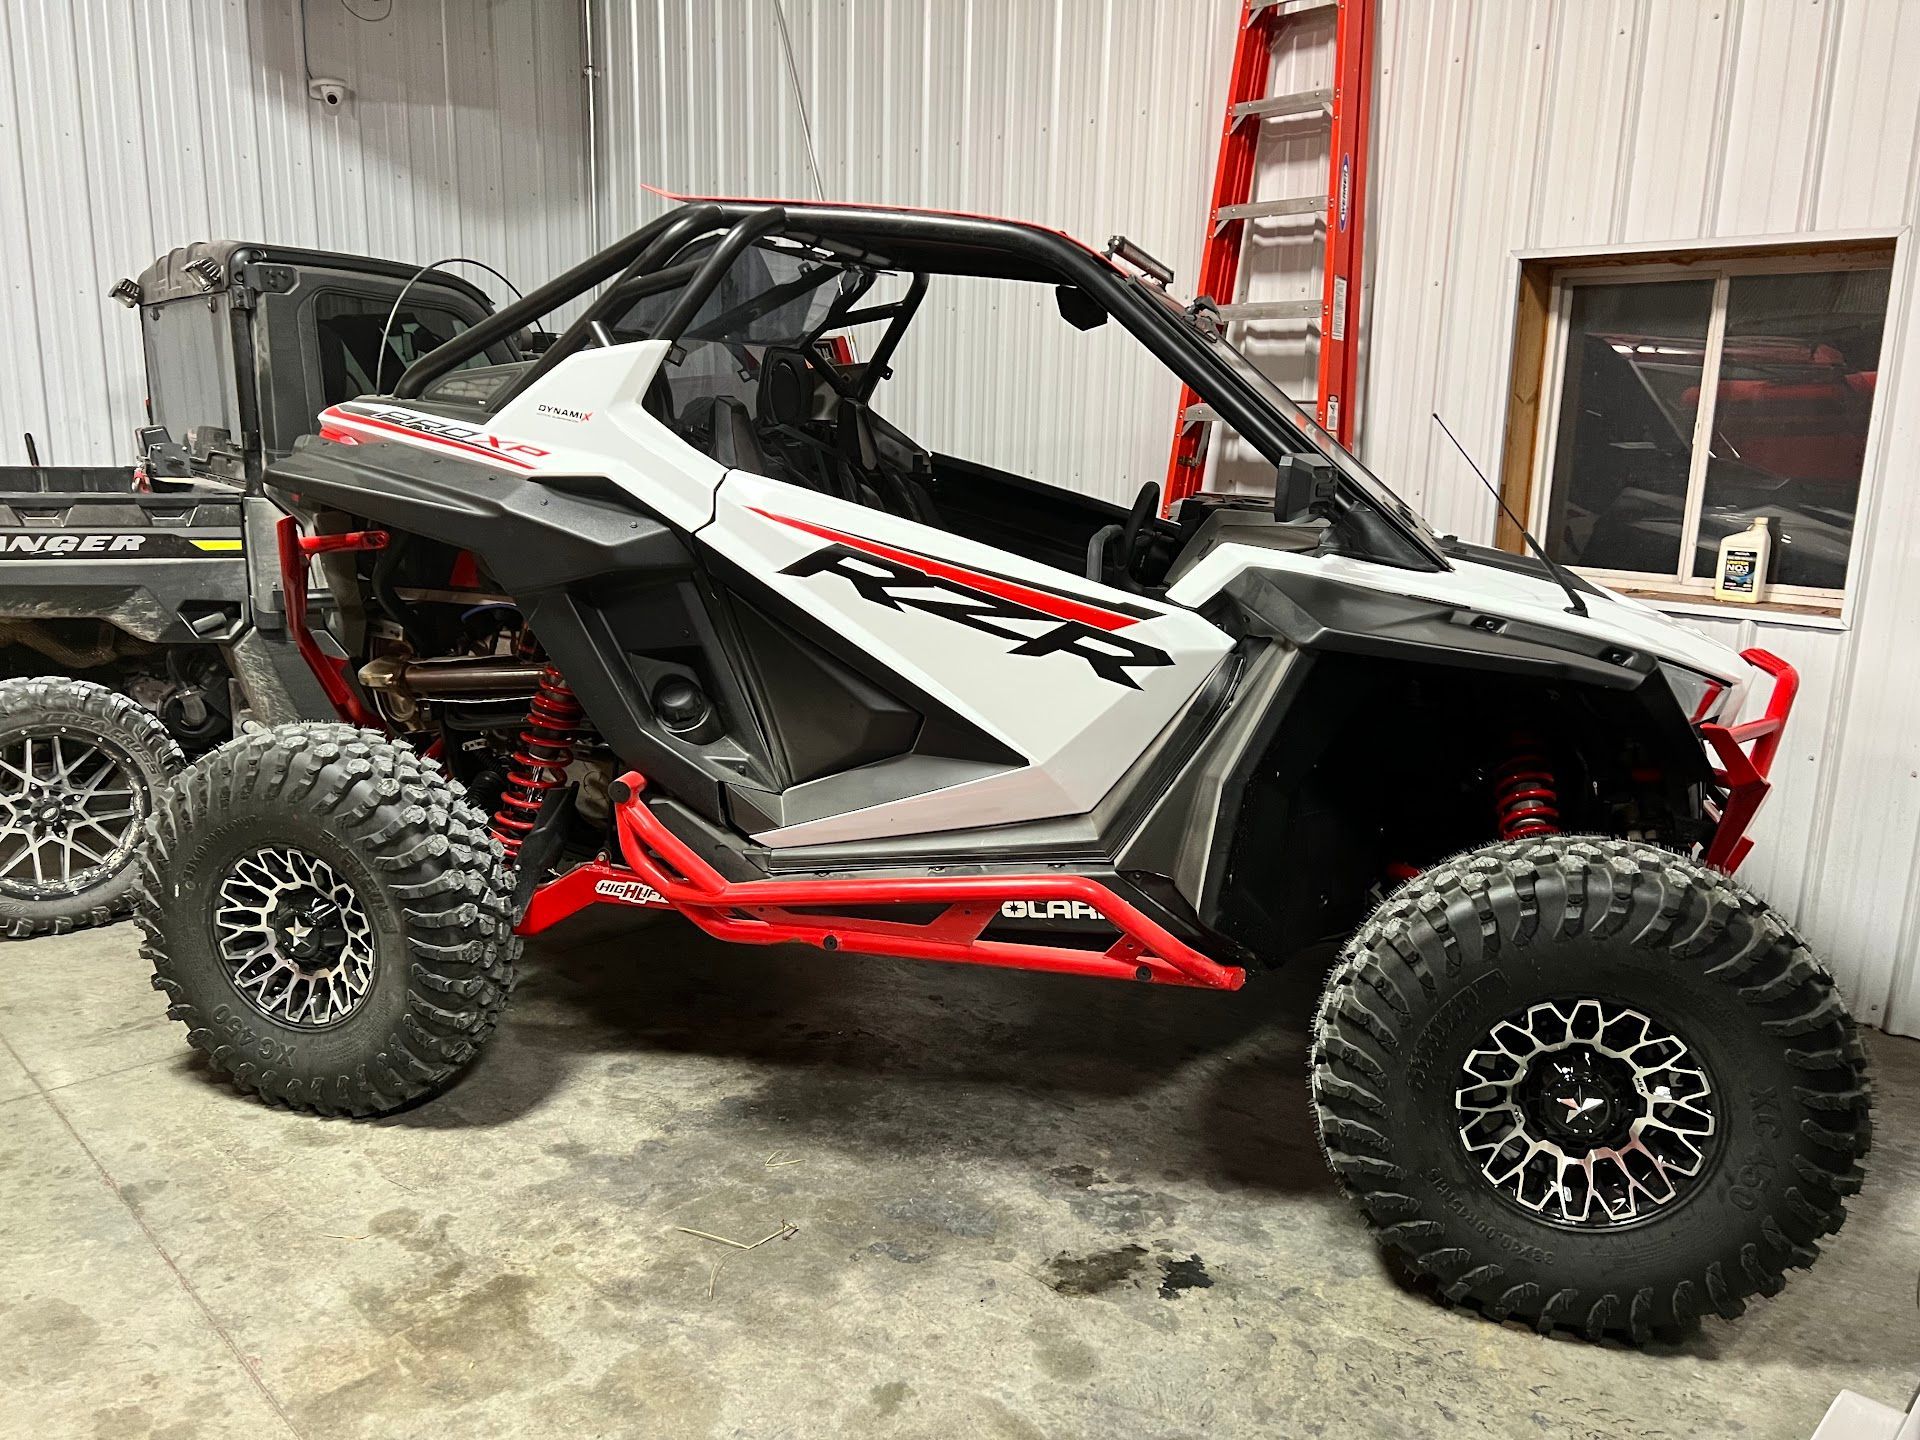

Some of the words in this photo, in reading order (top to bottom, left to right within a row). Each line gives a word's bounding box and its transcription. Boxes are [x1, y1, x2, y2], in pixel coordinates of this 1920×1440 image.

[538, 404, 593, 421] DYNAMIX
[371, 411, 483, 440] PRO
[472, 434, 552, 457] XP
[0, 535, 146, 553] NGER
[776, 543, 1176, 691] RZR
[598, 881, 663, 901] HIGHLIF
